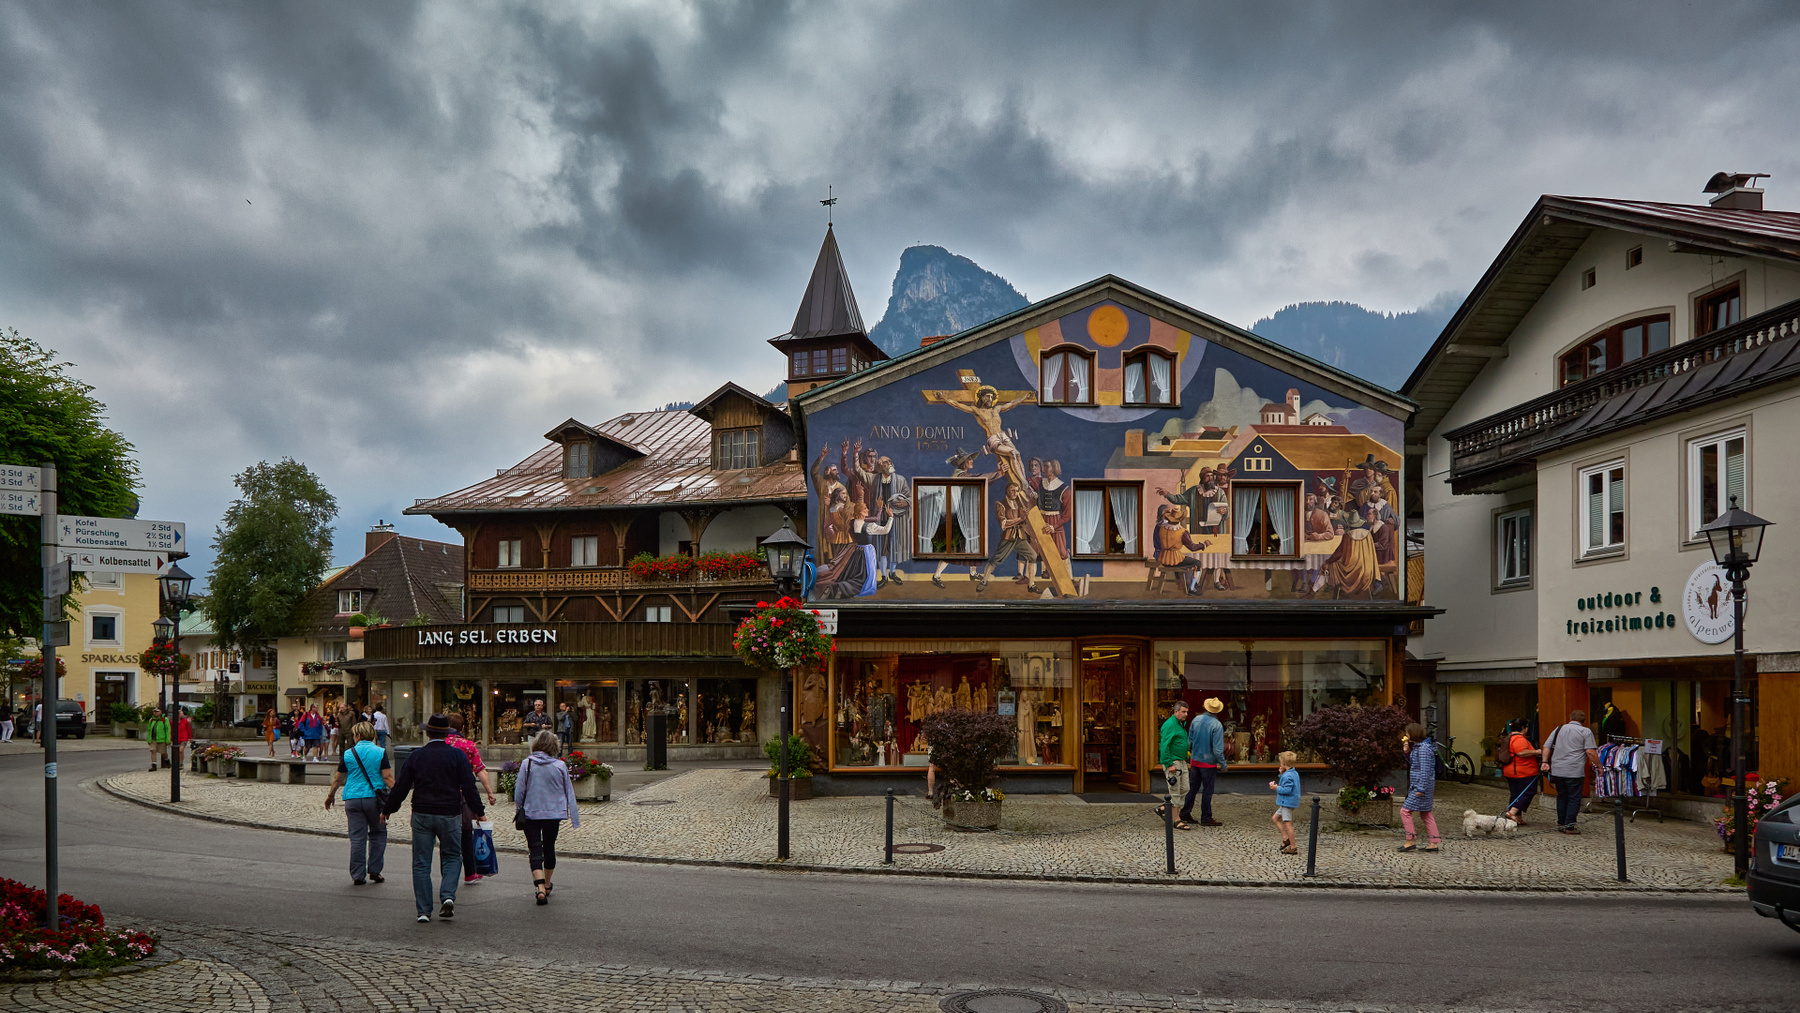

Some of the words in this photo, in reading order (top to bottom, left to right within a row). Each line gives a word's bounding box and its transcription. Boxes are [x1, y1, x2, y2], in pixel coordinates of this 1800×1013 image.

[870, 426, 911, 439] ANNO
[916, 426, 964, 439] DOMINI
[8, 494, 23, 502] Std
[8, 503, 23, 511] Std
[75, 519, 98, 527] Kofel
[158, 524, 172, 532] Std
[75, 528, 120, 539] Pürschling
[75, 537, 128, 547] Kolbensattel
[158, 541, 172, 549] Std
[99, 556, 151, 567] Kolbensattel
[1577, 591, 1642, 612] outdoor
[1649, 586, 1661, 604] &
[1566, 611, 1676, 635] freizeitmode
[1689, 613, 1735, 636] alpenwel
[418, 630, 454, 646] LANG
[460, 630, 492, 644] SEL.
[496, 629, 558, 643] ERBEN
[81, 654, 139, 664] SPARKASS
